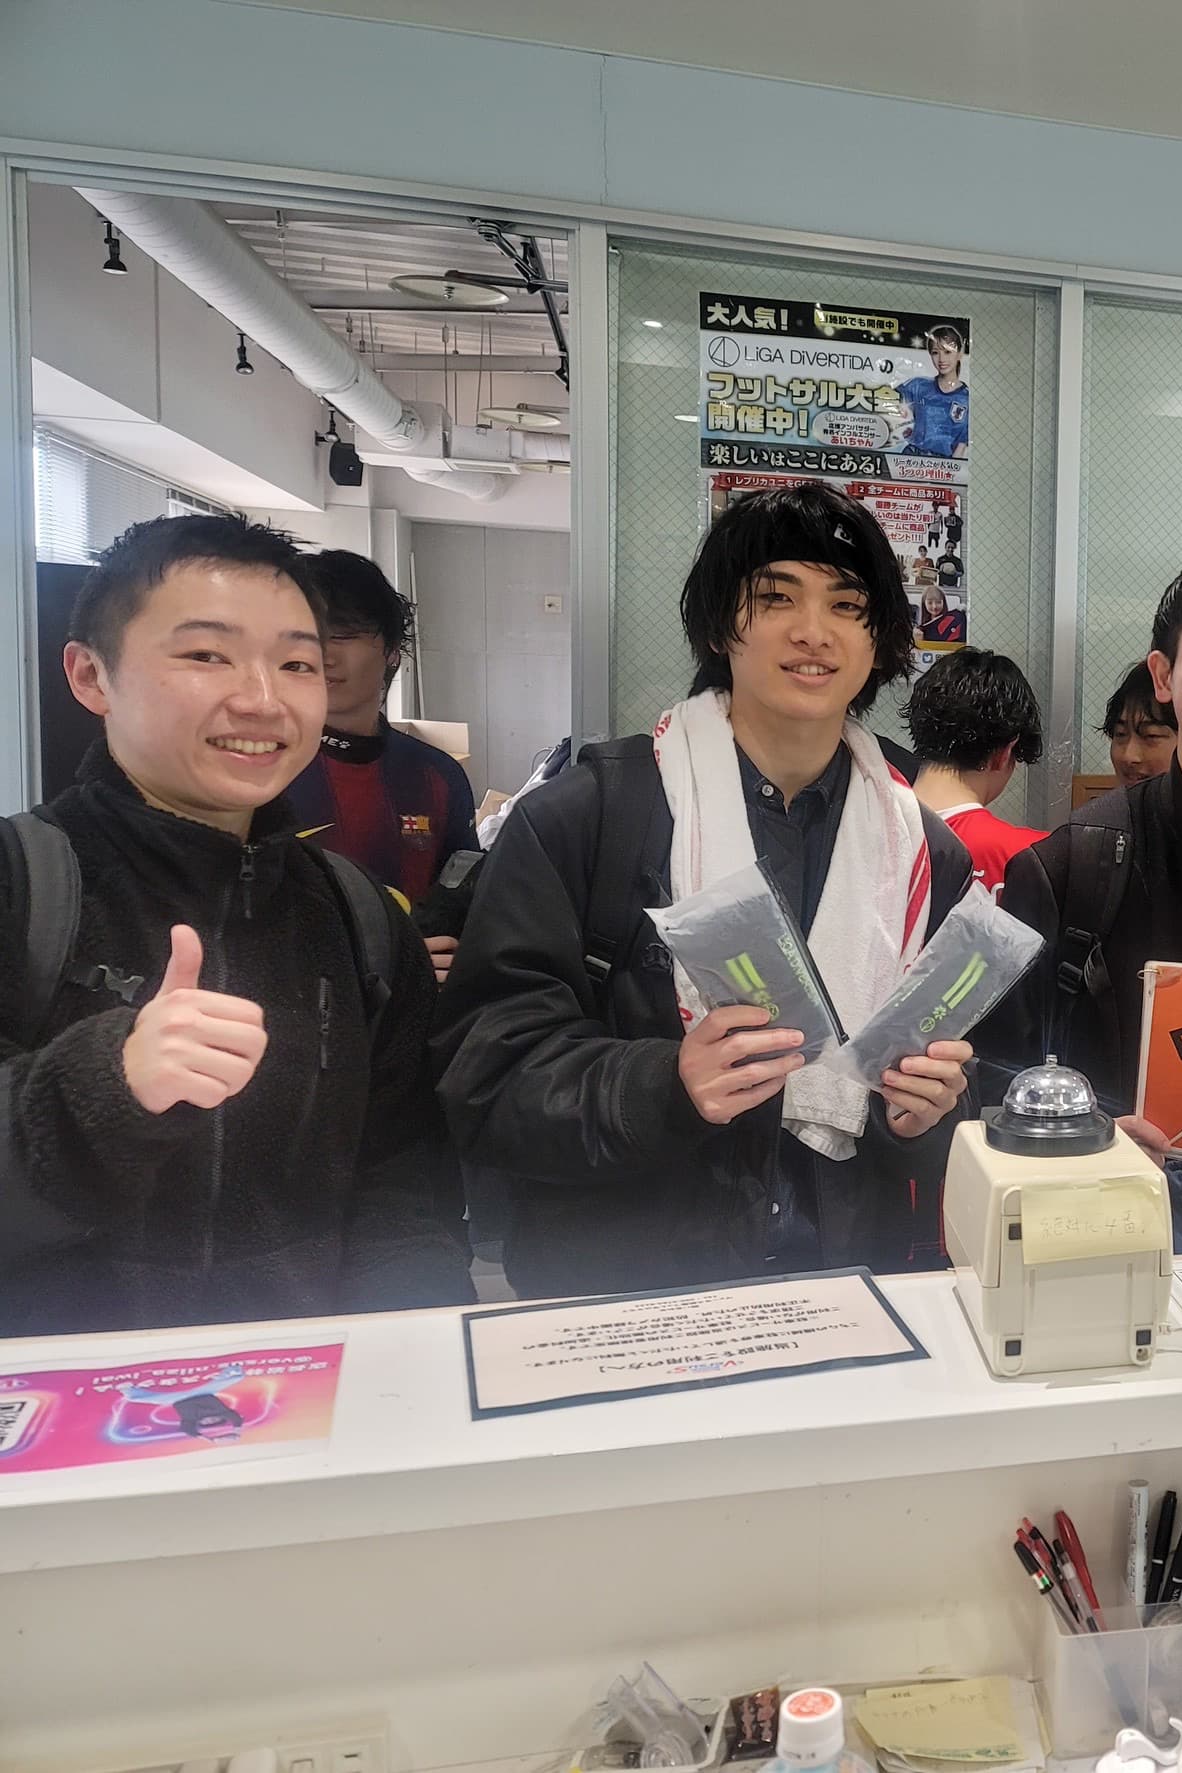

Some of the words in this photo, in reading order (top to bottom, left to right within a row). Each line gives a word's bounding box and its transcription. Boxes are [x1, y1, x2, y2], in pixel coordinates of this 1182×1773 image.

[707, 372, 900, 413] フットサル大会
[830, 436, 873, 447] あいちゃん
